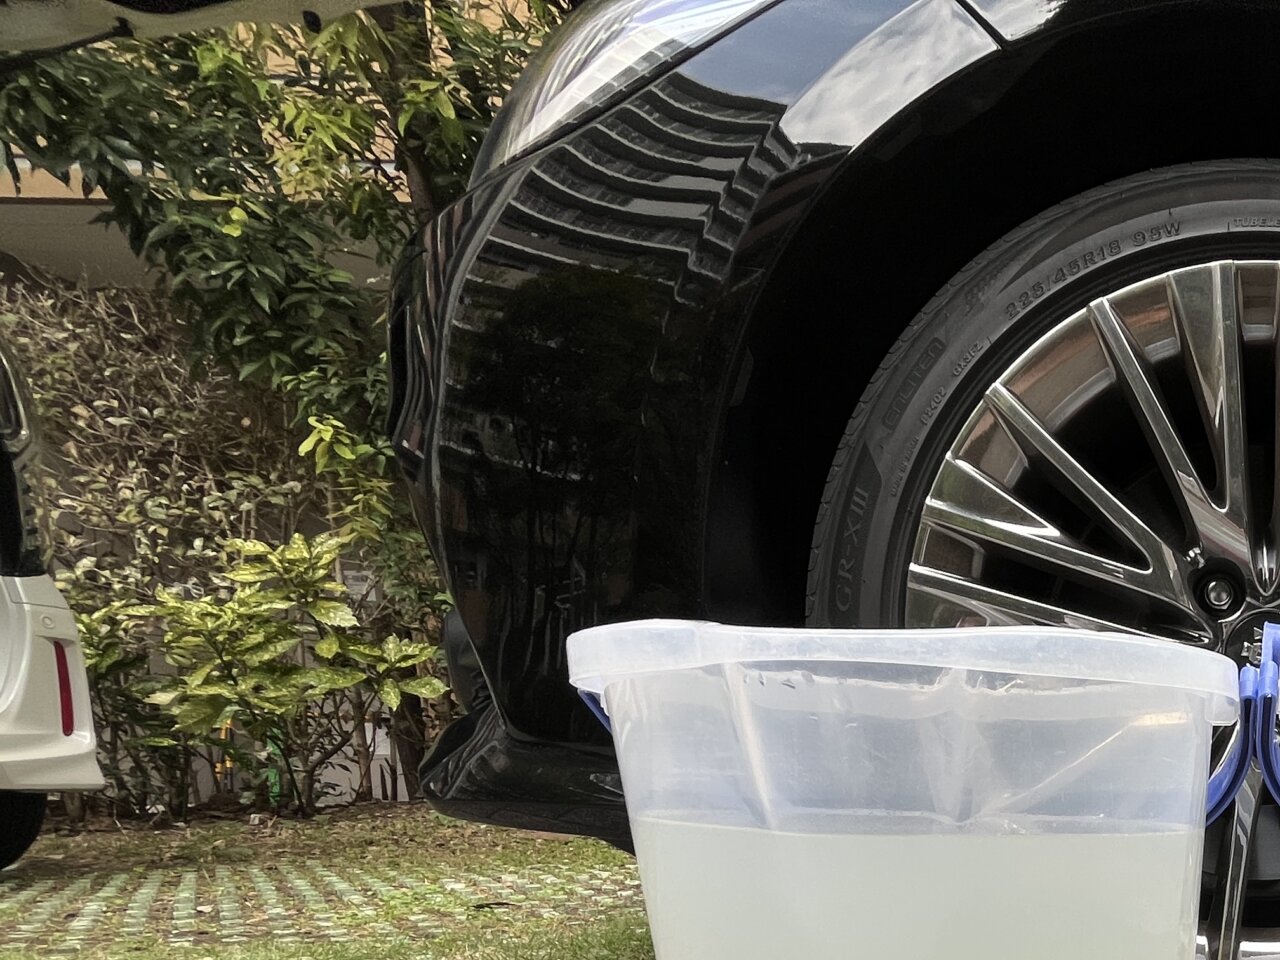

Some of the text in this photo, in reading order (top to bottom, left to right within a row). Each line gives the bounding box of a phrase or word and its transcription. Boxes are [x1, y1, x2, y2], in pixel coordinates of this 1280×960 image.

[1005, 220, 1182, 320] 225/45R18 95W
[835, 486, 870, 612] GR-XIII
